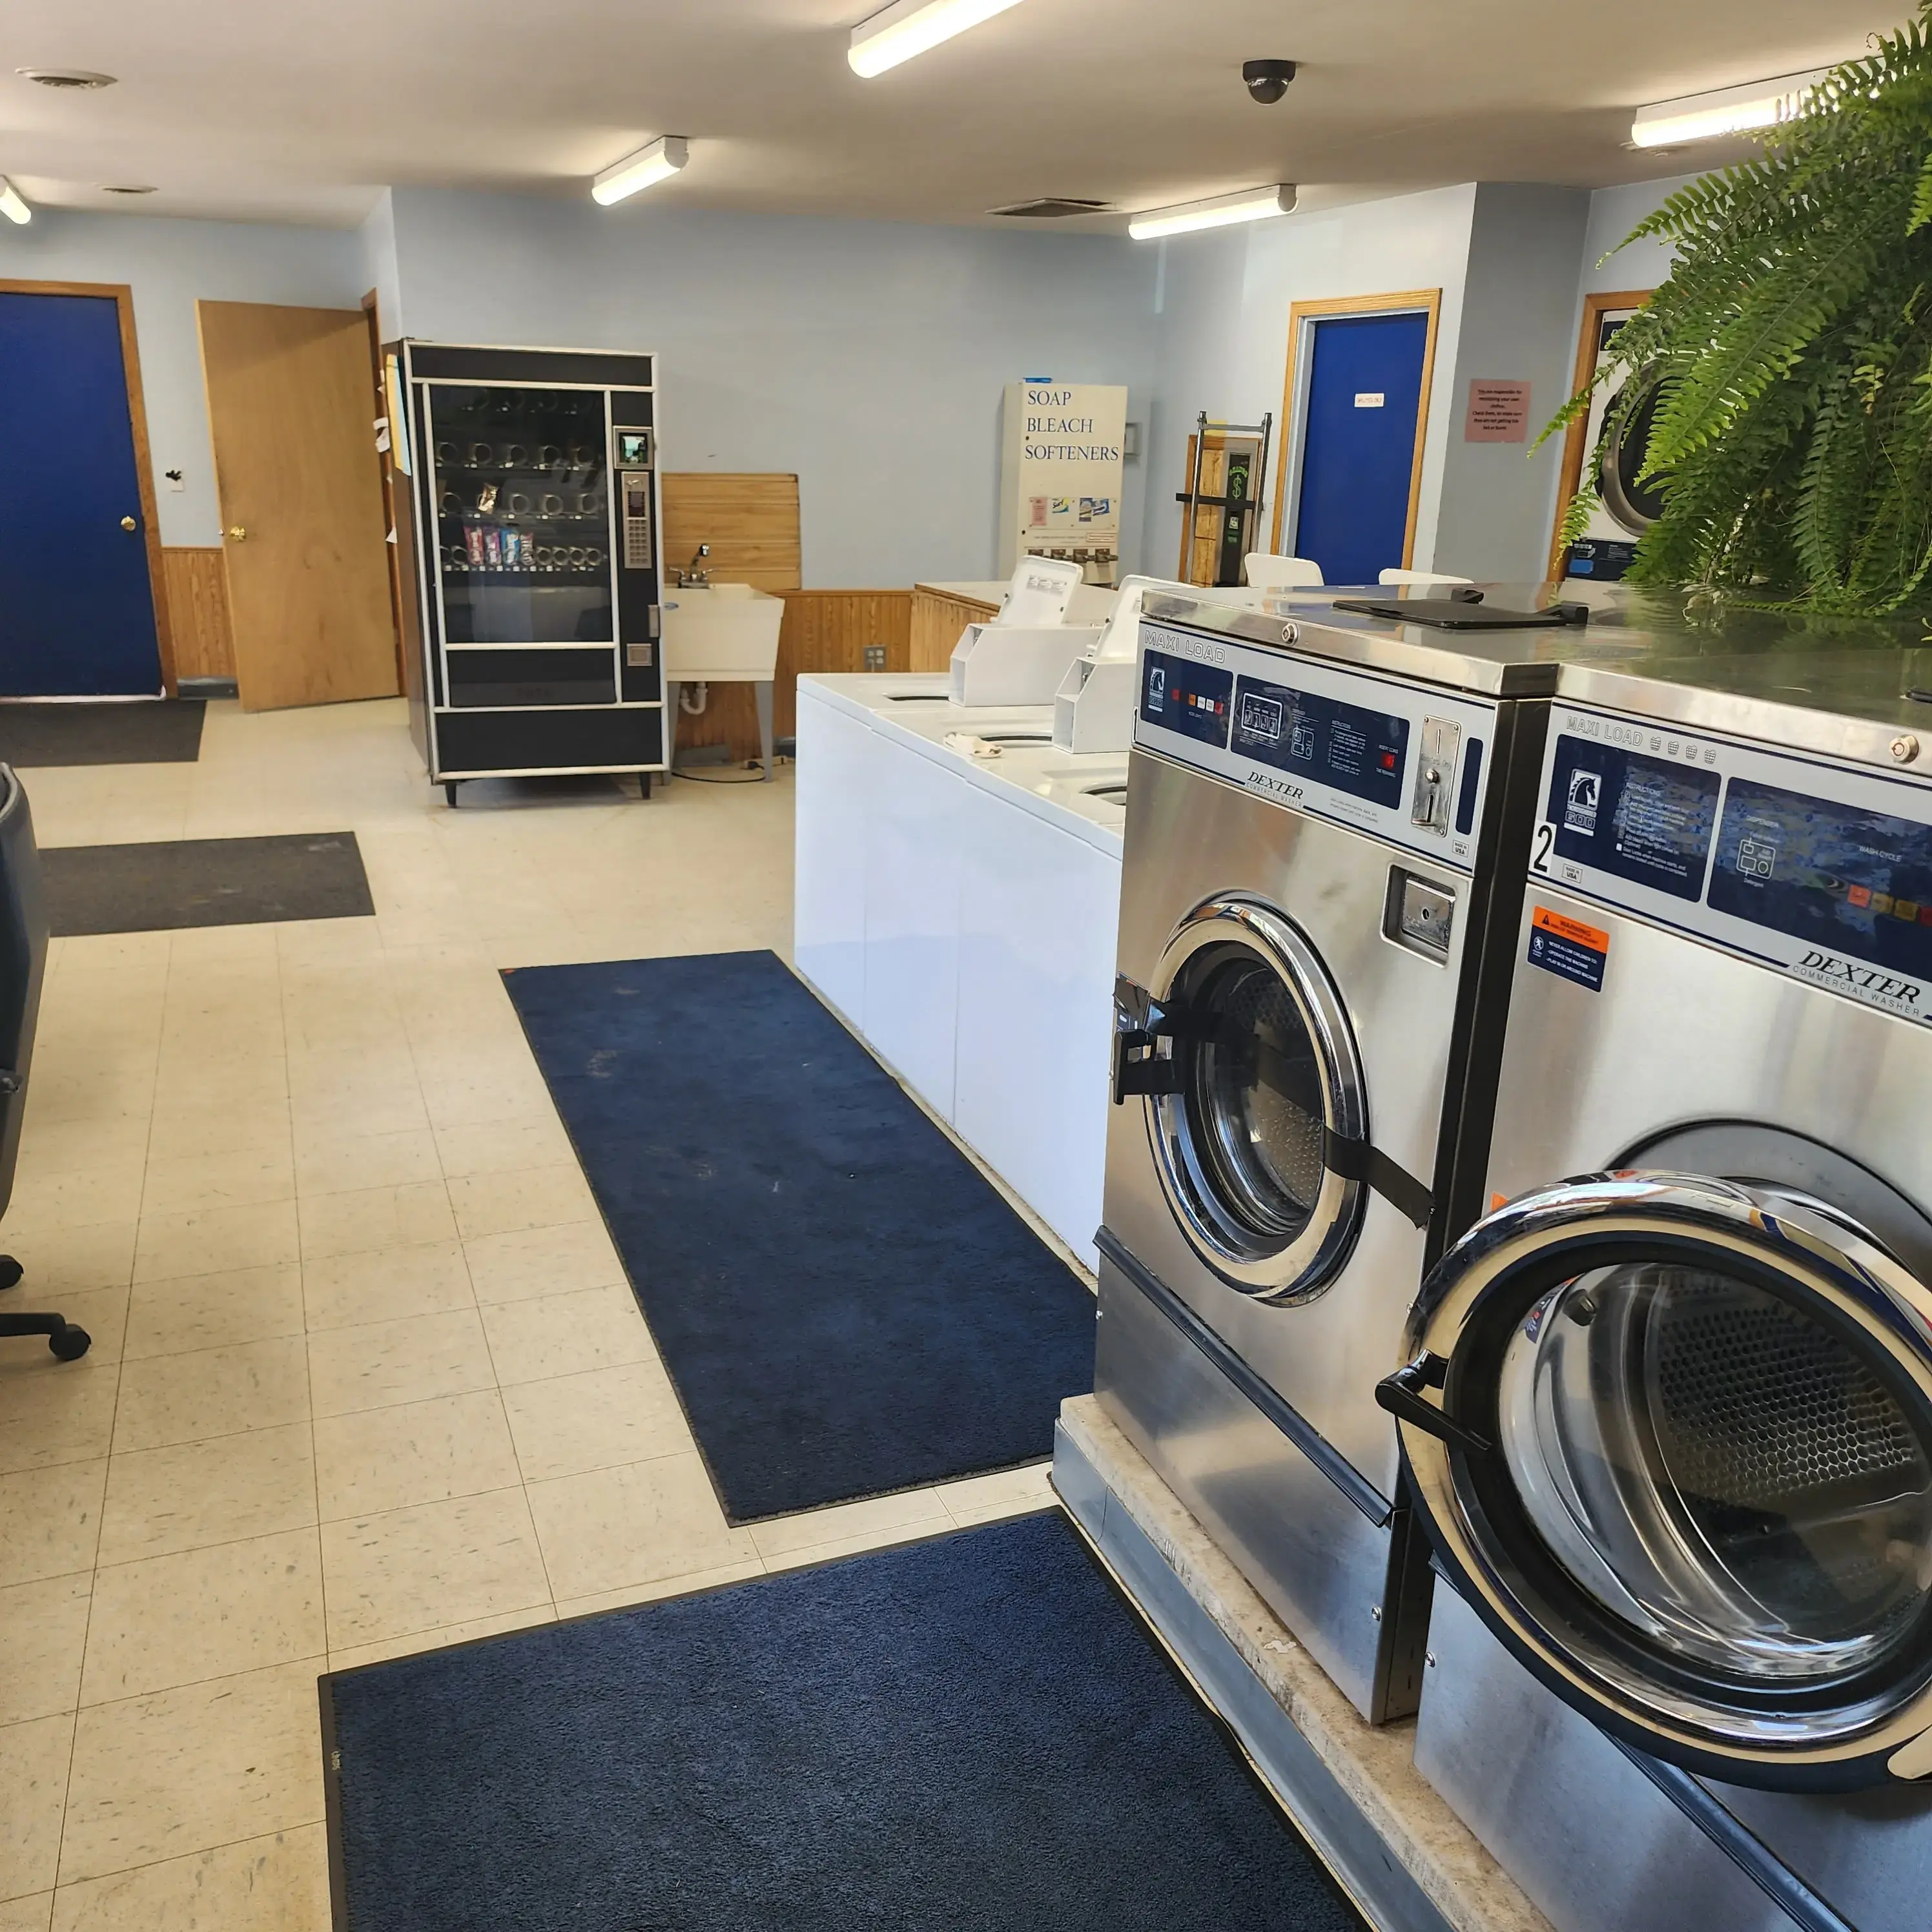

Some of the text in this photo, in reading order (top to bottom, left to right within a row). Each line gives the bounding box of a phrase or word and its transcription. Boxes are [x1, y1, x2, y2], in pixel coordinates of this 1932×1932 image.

[1027, 390, 1071, 406] SOAP
[1027, 418, 1093, 433] BLEACH
[1025, 445, 1119, 461] SOFTENERS
[1145, 630, 1226, 664] MAXI LOAD
[1566, 715, 1643, 746] MAXI LOAD
[1246, 782, 1302, 807] COMMERCIAL WASHER
[1247, 771, 1304, 800] DEXTER
[1565, 810, 1596, 830] 600
[1455, 847, 1465, 856] USA
[1533, 825, 1553, 873] 2
[1859, 845, 1902, 863] WASH CYCLE
[1567, 872, 1577, 880] USA
[1798, 950, 1921, 1004] DEXTER
[1793, 965, 1920, 1018] COMMERCIAL WASHER
